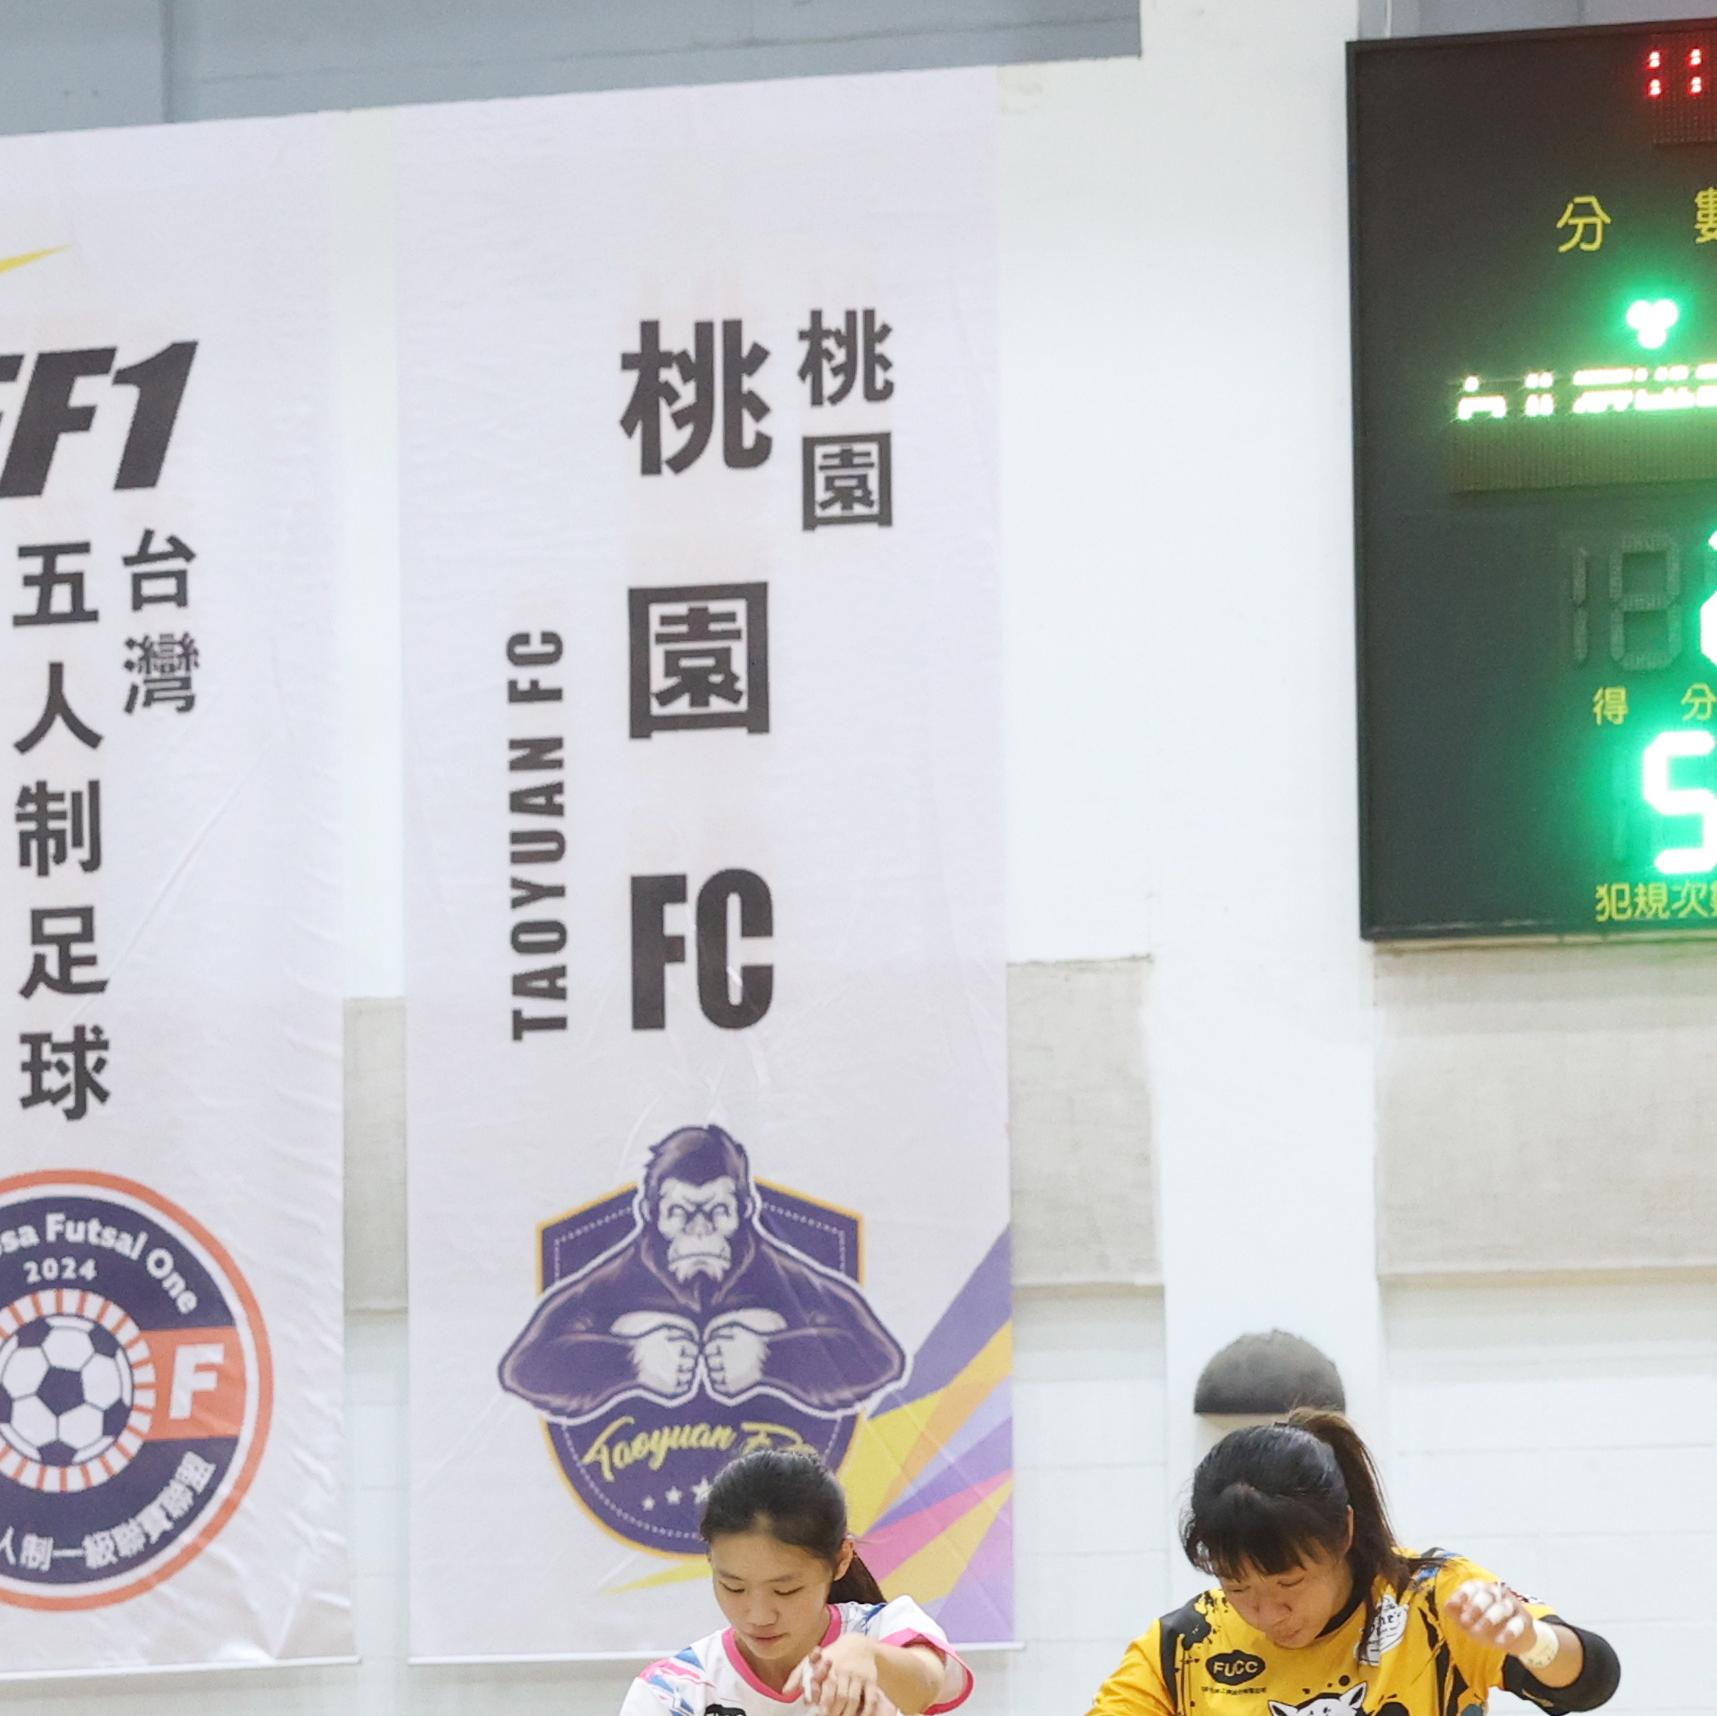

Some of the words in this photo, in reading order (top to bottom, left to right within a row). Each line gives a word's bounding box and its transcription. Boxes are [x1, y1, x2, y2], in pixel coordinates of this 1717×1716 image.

[798, 309, 894, 531] 桃園
[122, 529, 199, 714] 台灣
[506, 631, 563, 703] FC
[13, 541, 110, 1121] 五人制足球
[509, 737, 568, 1041] TAOYUAN
[23, 1257, 98, 1285] 2024
[45, 1212, 149, 1261] Futsal
[146, 1248, 198, 1315] One
[169, 1343, 225, 1420] F
[1212, 1660, 1259, 1678] FUCC
